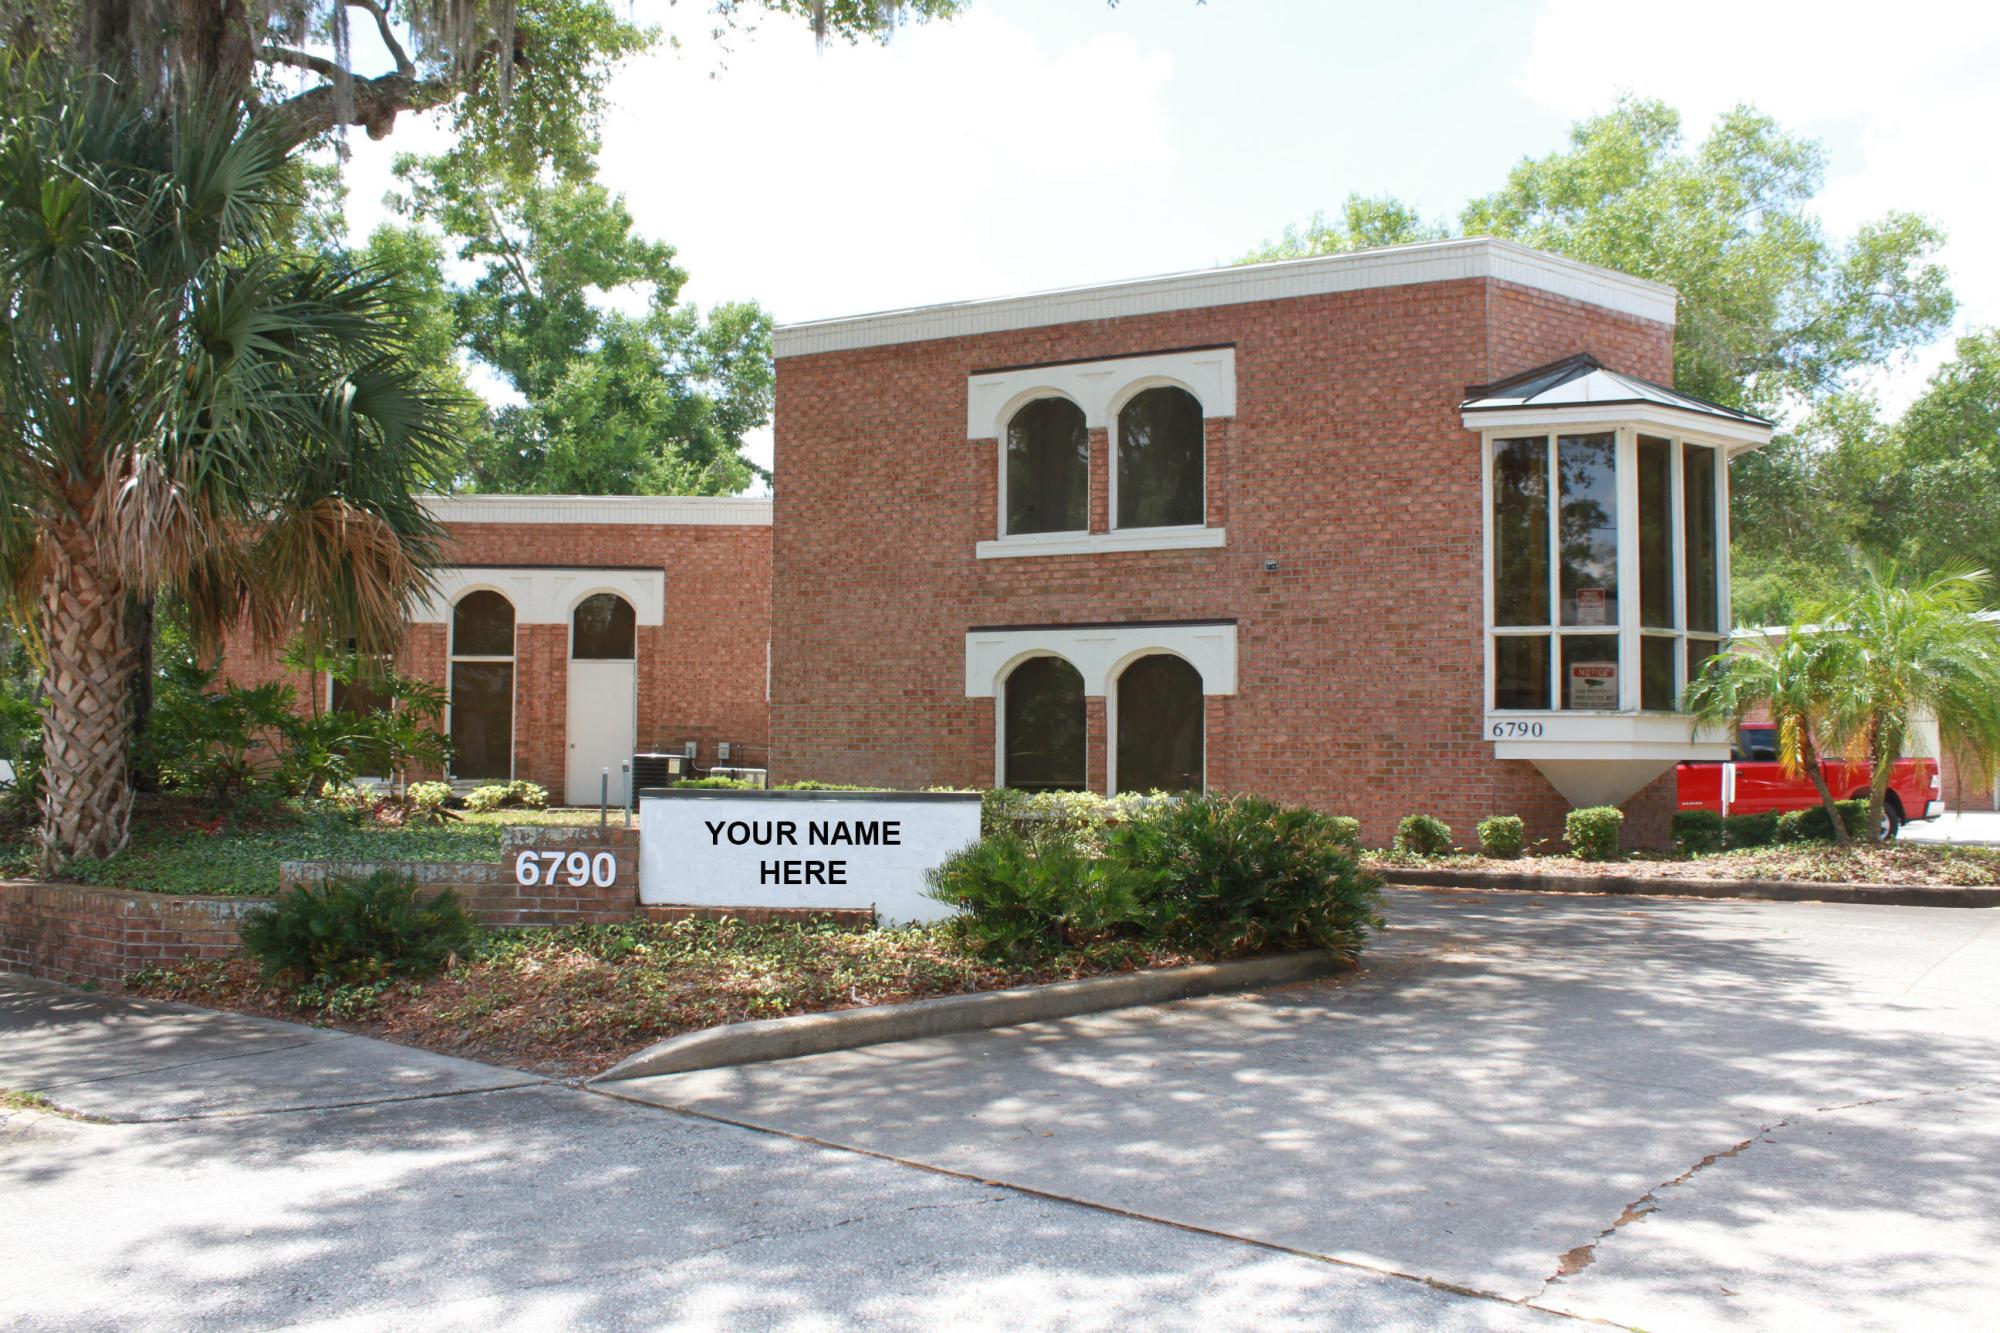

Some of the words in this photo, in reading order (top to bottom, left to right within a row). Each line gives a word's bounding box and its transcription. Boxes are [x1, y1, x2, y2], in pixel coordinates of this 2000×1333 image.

[1578, 668, 1609, 677] NOTICE
[1492, 721, 1543, 737] 6790
[705, 821, 797, 846] YOUR
[808, 821, 901, 846] NAME
[515, 850, 617, 888] 6790
[760, 860, 847, 885] HERE
